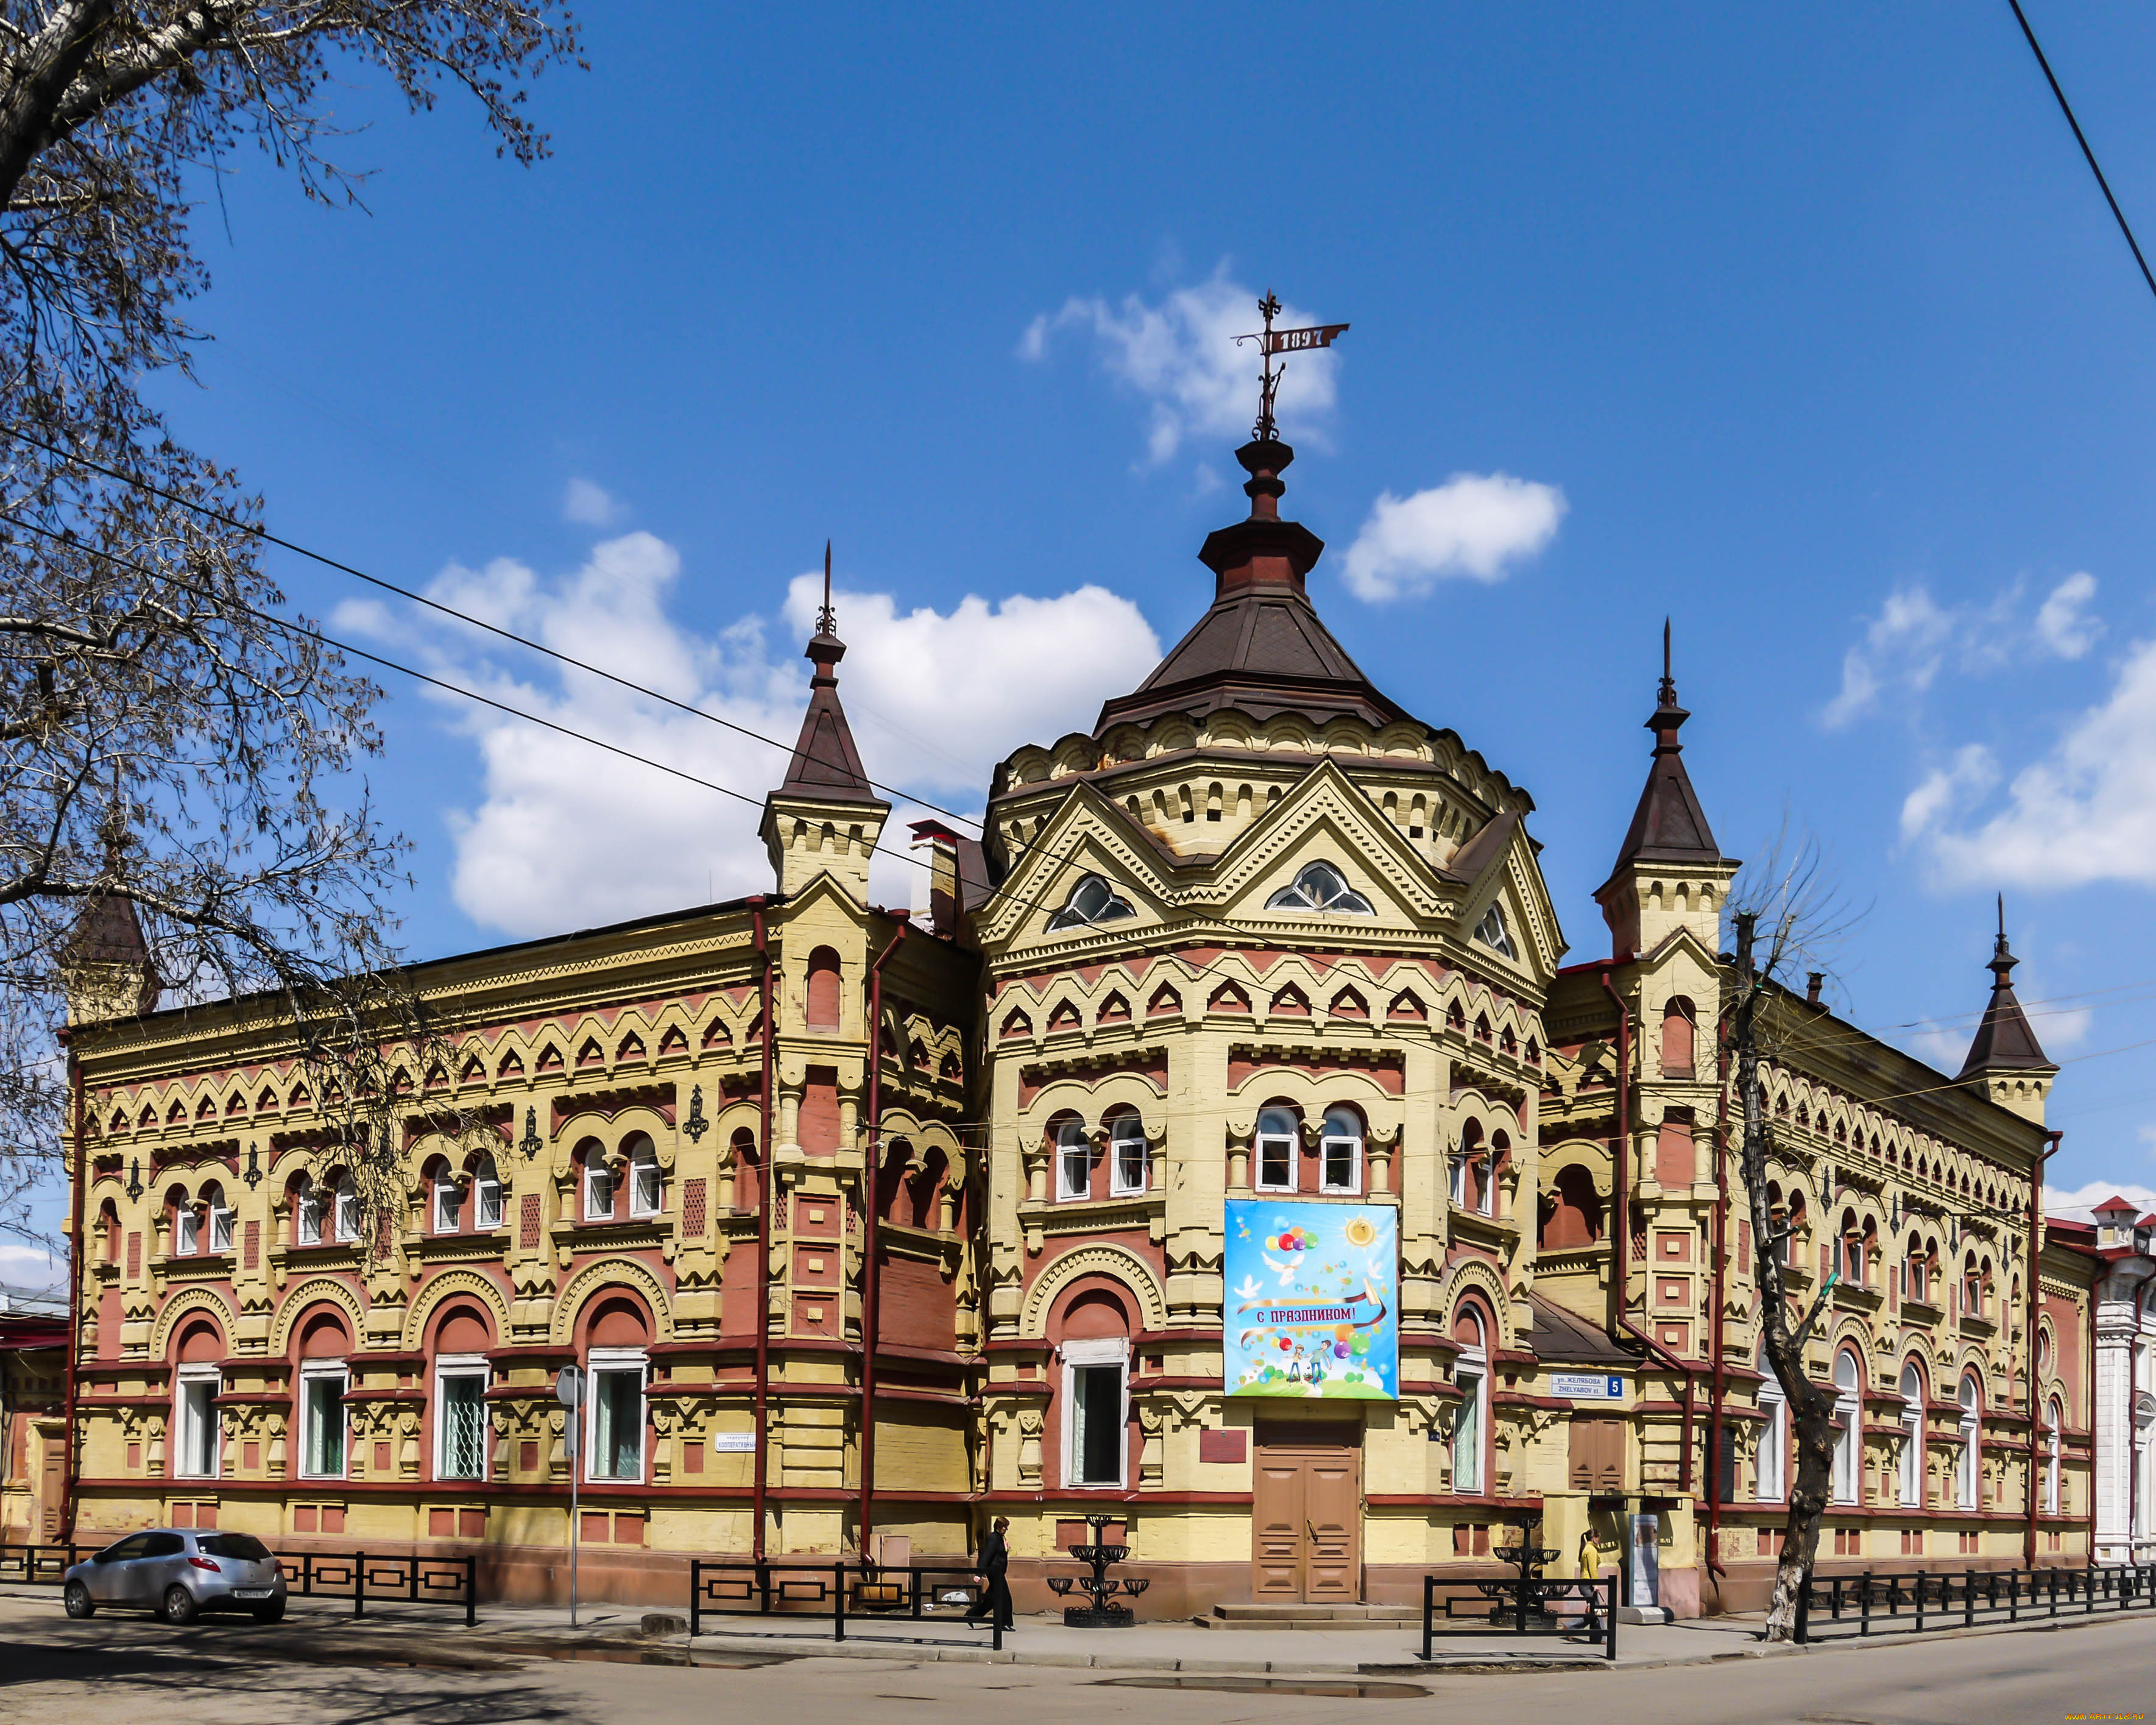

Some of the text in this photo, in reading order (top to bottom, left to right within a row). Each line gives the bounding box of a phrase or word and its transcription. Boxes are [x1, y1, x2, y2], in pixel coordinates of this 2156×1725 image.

[1280, 330, 1323, 349] 1897
[1257, 1308, 1355, 1323] С ПРАЗДНИКОМ!
[1612, 1381, 1619, 1393] 5
